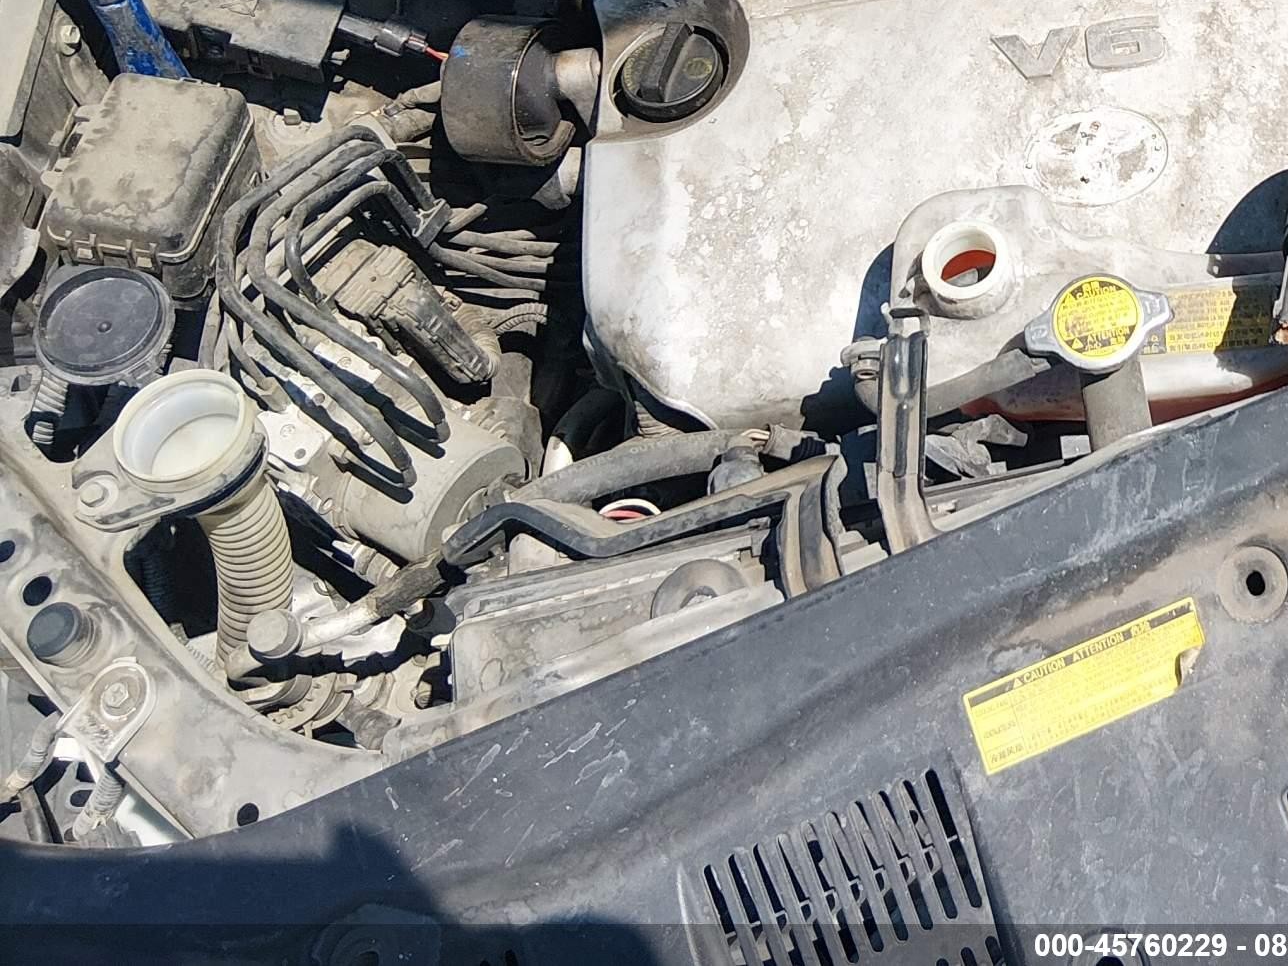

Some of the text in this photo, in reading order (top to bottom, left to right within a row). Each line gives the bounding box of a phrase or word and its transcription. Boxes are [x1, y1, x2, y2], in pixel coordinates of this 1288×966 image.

[990, 16, 1165, 79] V6
[1075, 285, 1117, 301] CAUTION
[1023, 656, 1067, 684] CAUTION
[1072, 632, 1125, 663] ATTENTION
